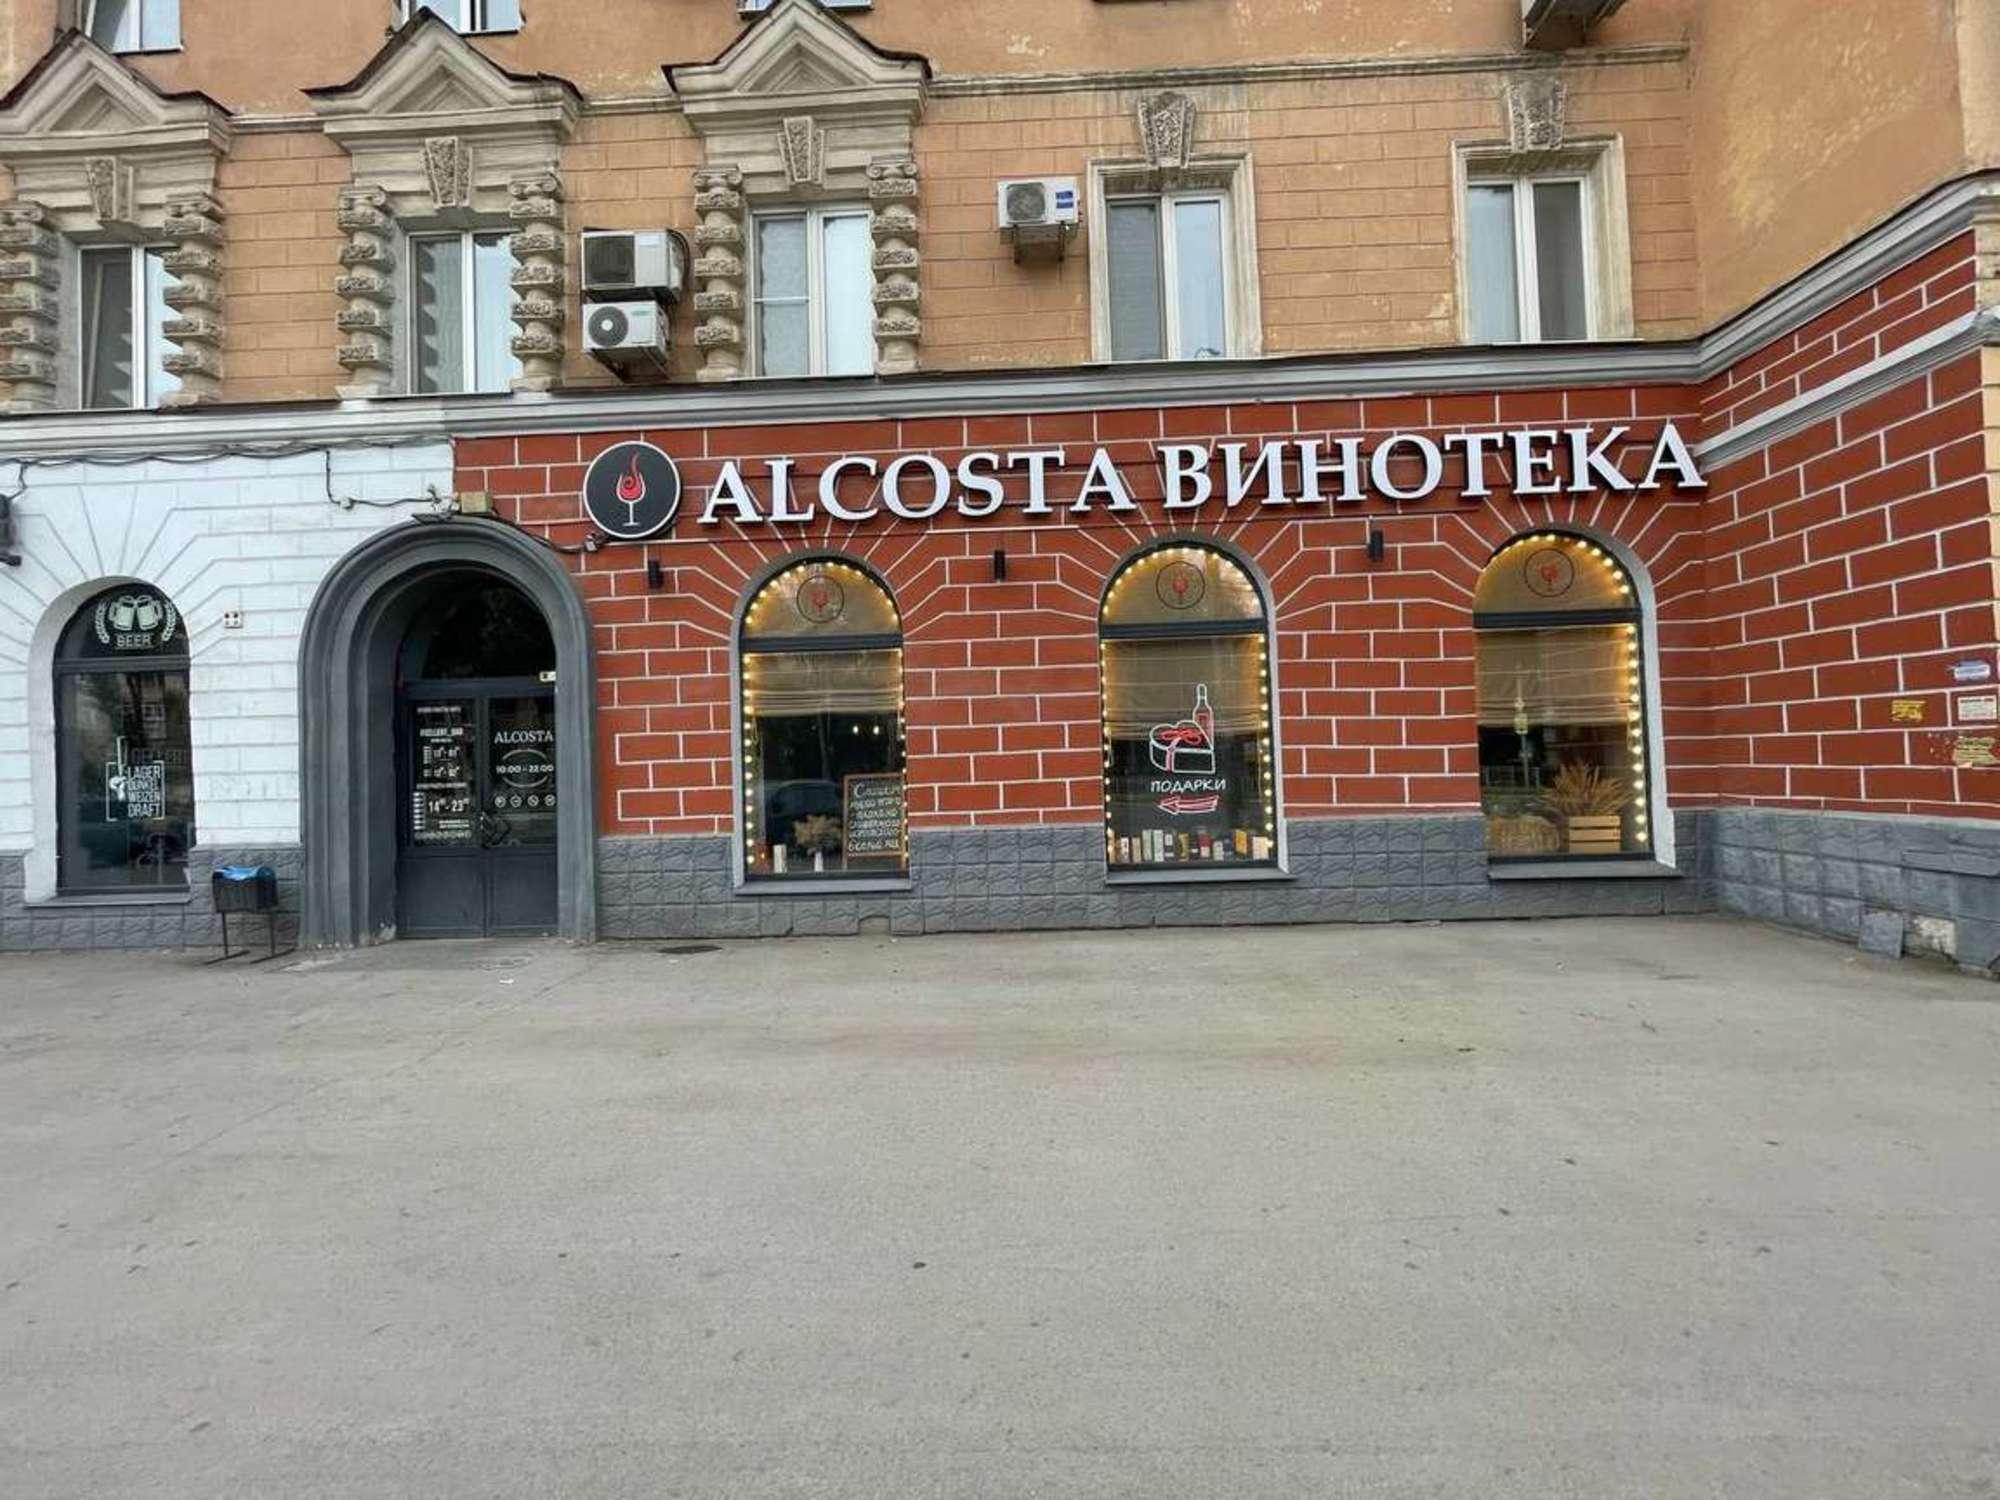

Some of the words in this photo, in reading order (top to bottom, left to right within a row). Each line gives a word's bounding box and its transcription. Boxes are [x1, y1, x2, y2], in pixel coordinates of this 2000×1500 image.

[697, 447, 1137, 524] ALCOSTA
[1157, 423, 1708, 509] ВИНОТЕКА
[116, 634, 151, 647] BEER
[494, 730, 554, 744] ALCOSTA
[127, 766, 160, 780] LAGER
[1150, 779, 1226, 793] ПОДАРКИ
[127, 803, 160, 817] DRAFT
